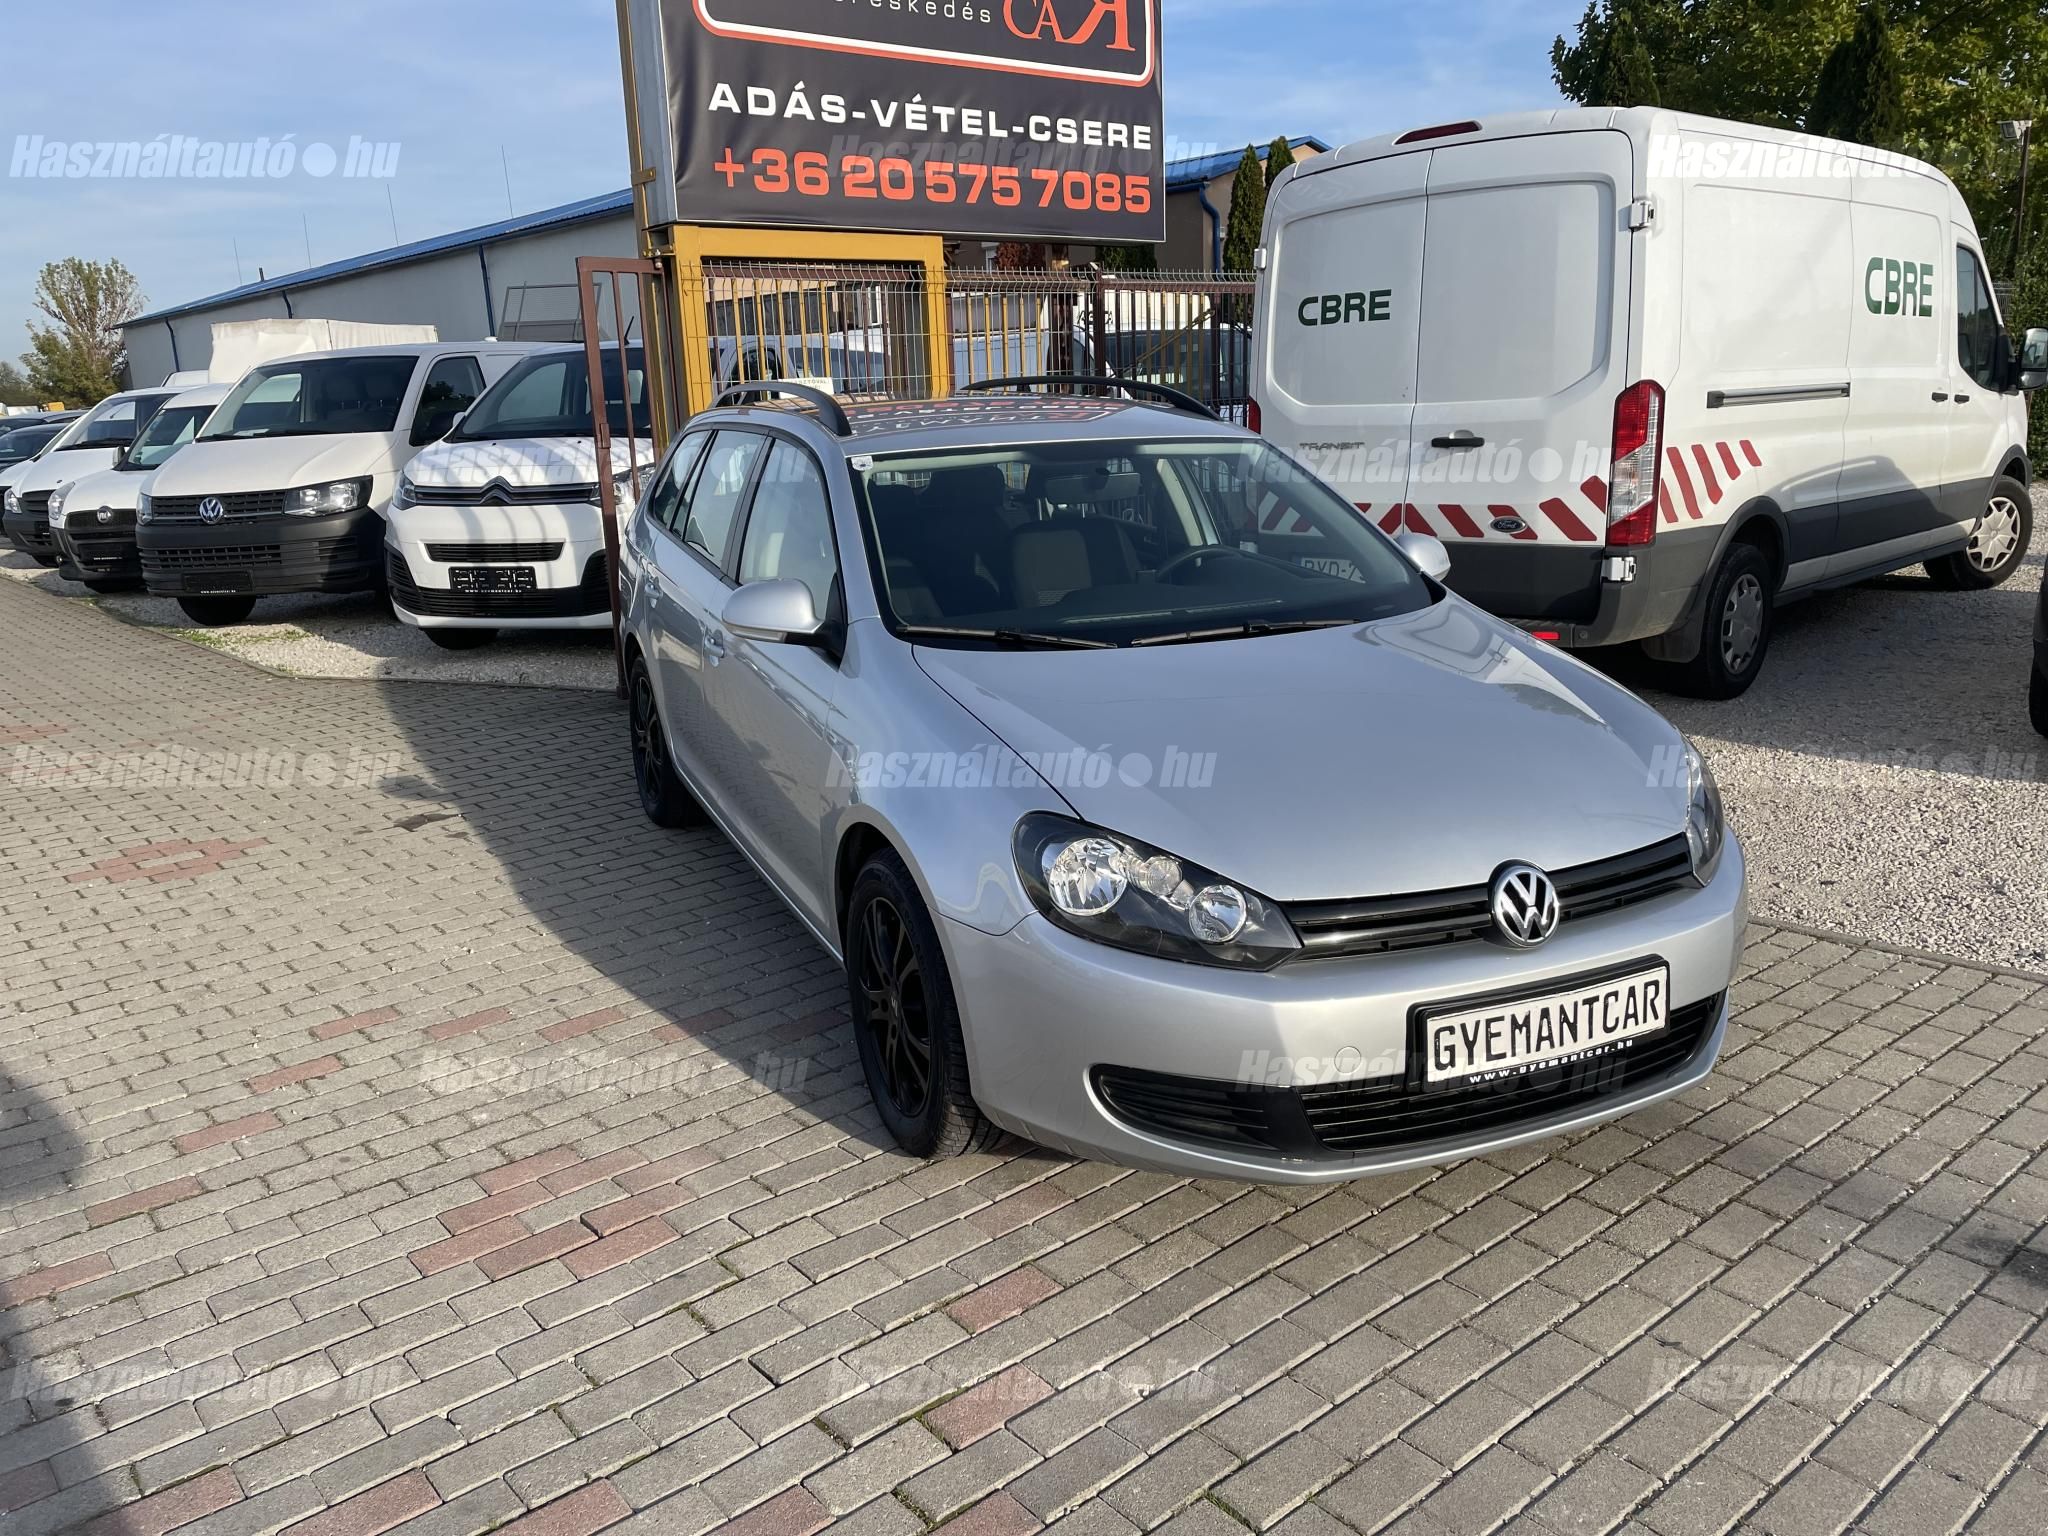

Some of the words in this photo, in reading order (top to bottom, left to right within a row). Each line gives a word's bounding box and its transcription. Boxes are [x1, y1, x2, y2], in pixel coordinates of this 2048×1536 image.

[708, 82, 1152, 151] ADÁS-VÉTEL-CSERE
[714, 147, 830, 197] +36
[841, 155, 915, 201] 20
[924, 160, 1021, 206] 575
[1031, 169, 1152, 214] 7085
[1298, 289, 1392, 326] CBRE
[1865, 257, 1933, 317] CBRE
[1434, 979, 1660, 1072] GYEMANTCAR
